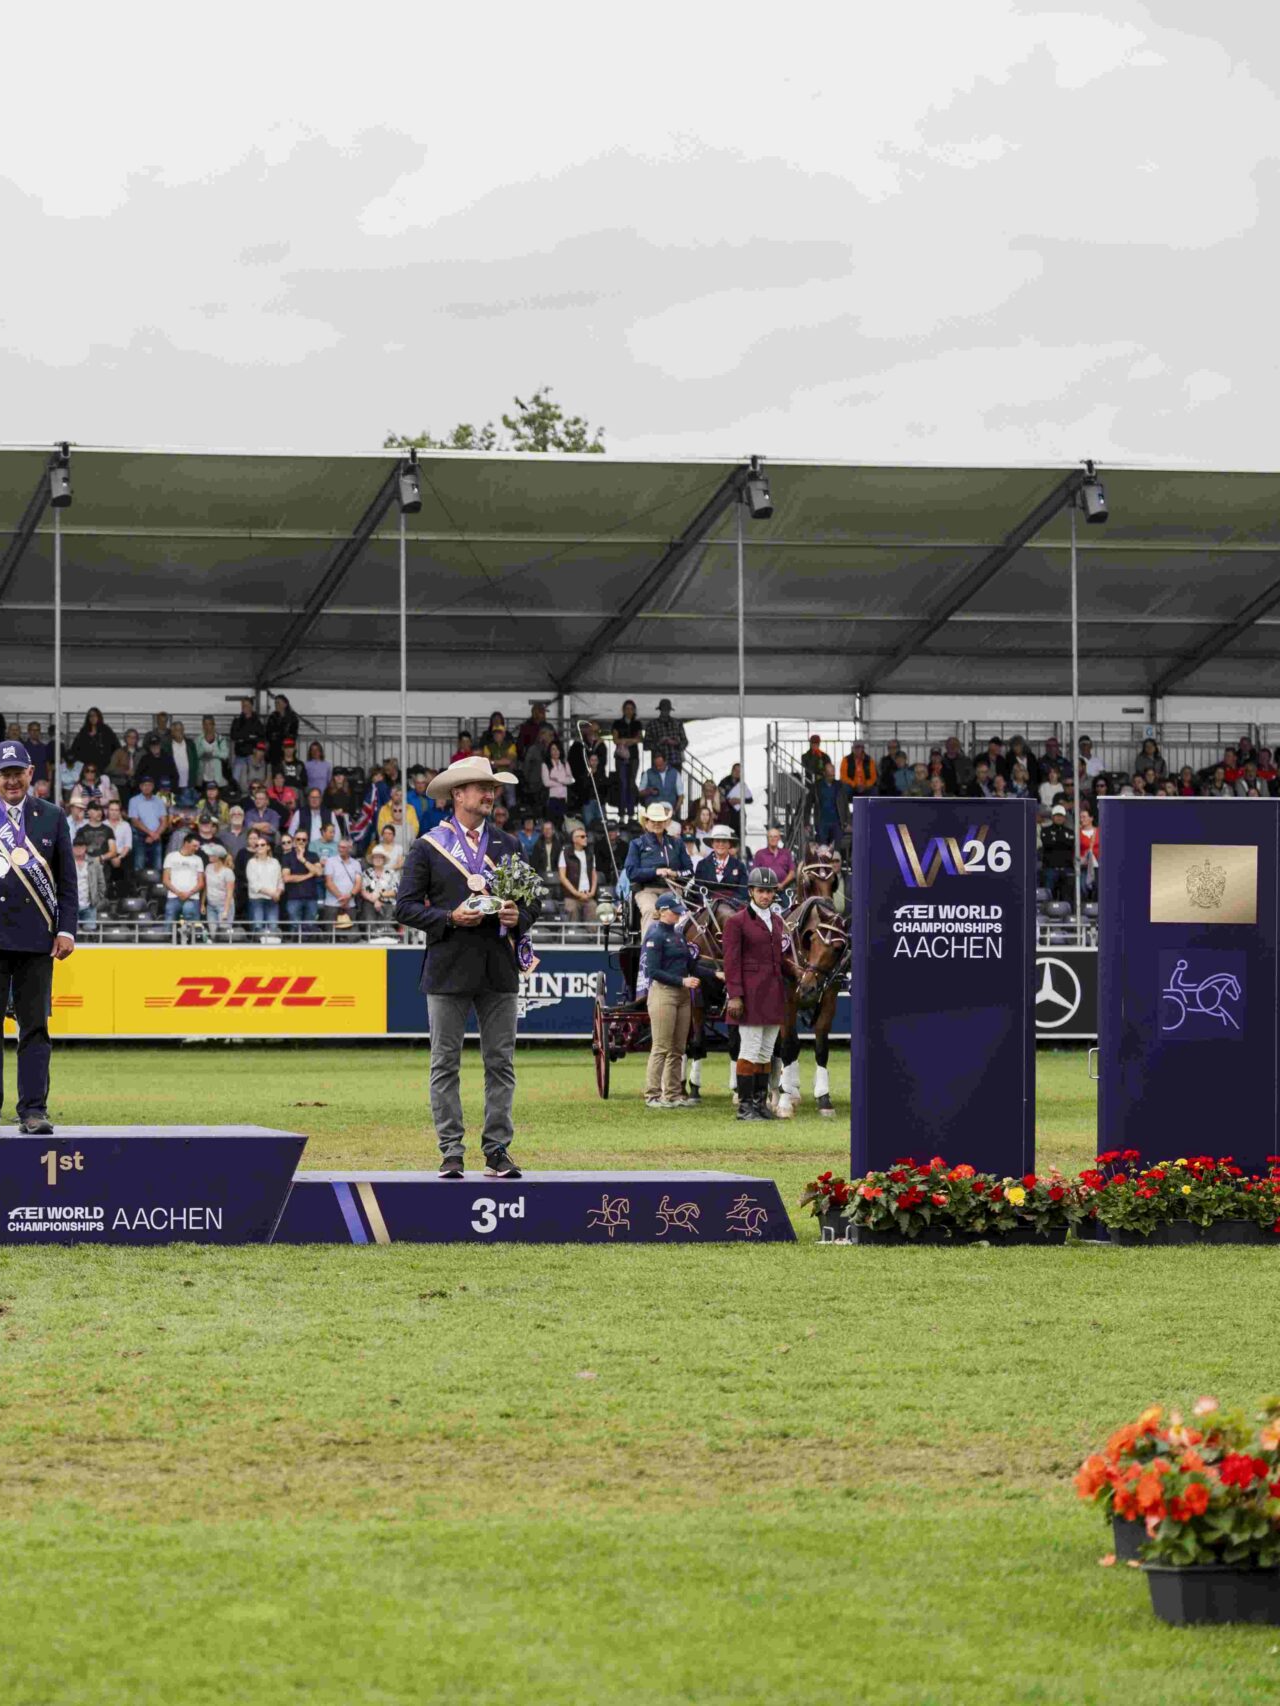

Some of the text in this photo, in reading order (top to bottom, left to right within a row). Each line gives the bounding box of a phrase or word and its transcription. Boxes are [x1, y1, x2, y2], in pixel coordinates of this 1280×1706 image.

[31, 862, 47, 885] WORLD
[893, 905, 1003, 919] FEI WORLD
[893, 922, 1003, 933] CHAMPIONSHIPS
[893, 936, 1003, 959] AACHEN
[174, 977, 326, 1007] DHL
[40, 1151, 84, 1185] 1st
[8, 1207, 104, 1219] FEI WORLD
[112, 1208, 222, 1230] AACHEN
[471, 1196, 525, 1234] 3rd
[8, 1222, 104, 1231] CHAMPIONSHIPS
